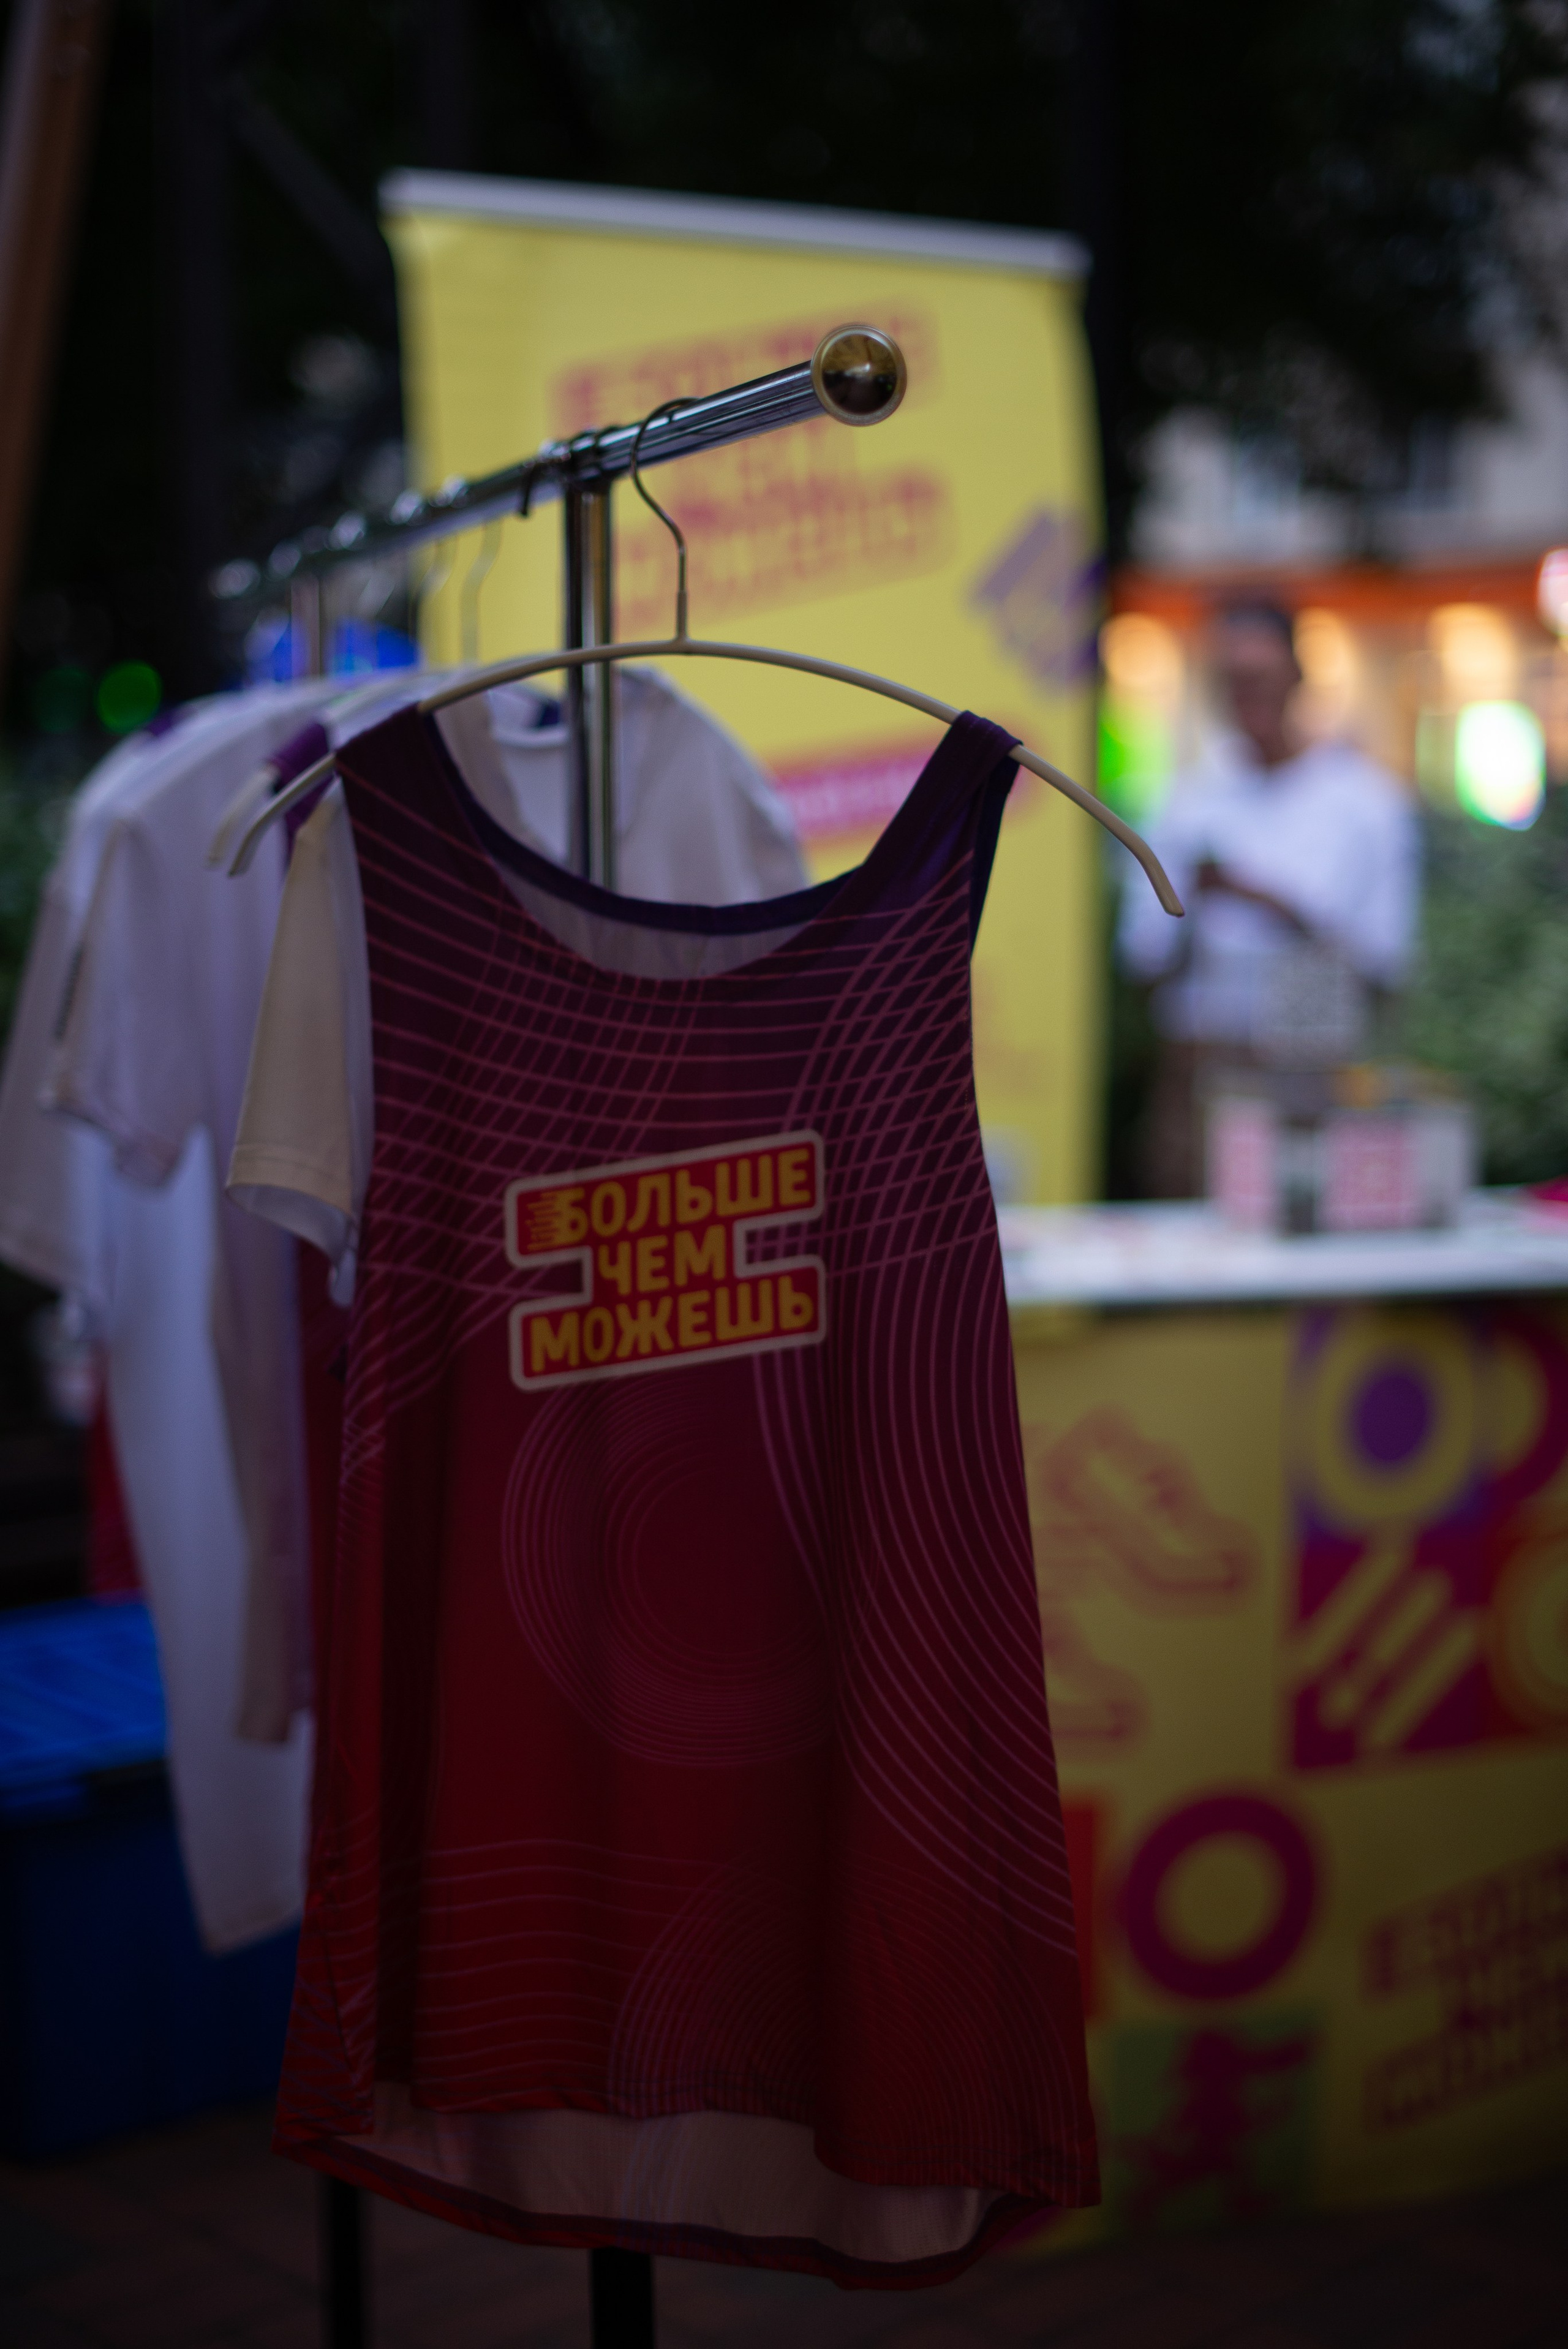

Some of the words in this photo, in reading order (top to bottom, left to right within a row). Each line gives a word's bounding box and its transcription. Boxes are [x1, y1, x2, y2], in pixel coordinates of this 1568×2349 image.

[527, 1148, 812, 1250] БОЛЬШЕ
[598, 1225, 726, 1296] ЧЕМ
[530, 1276, 814, 1373] МОЖЕШЬ
